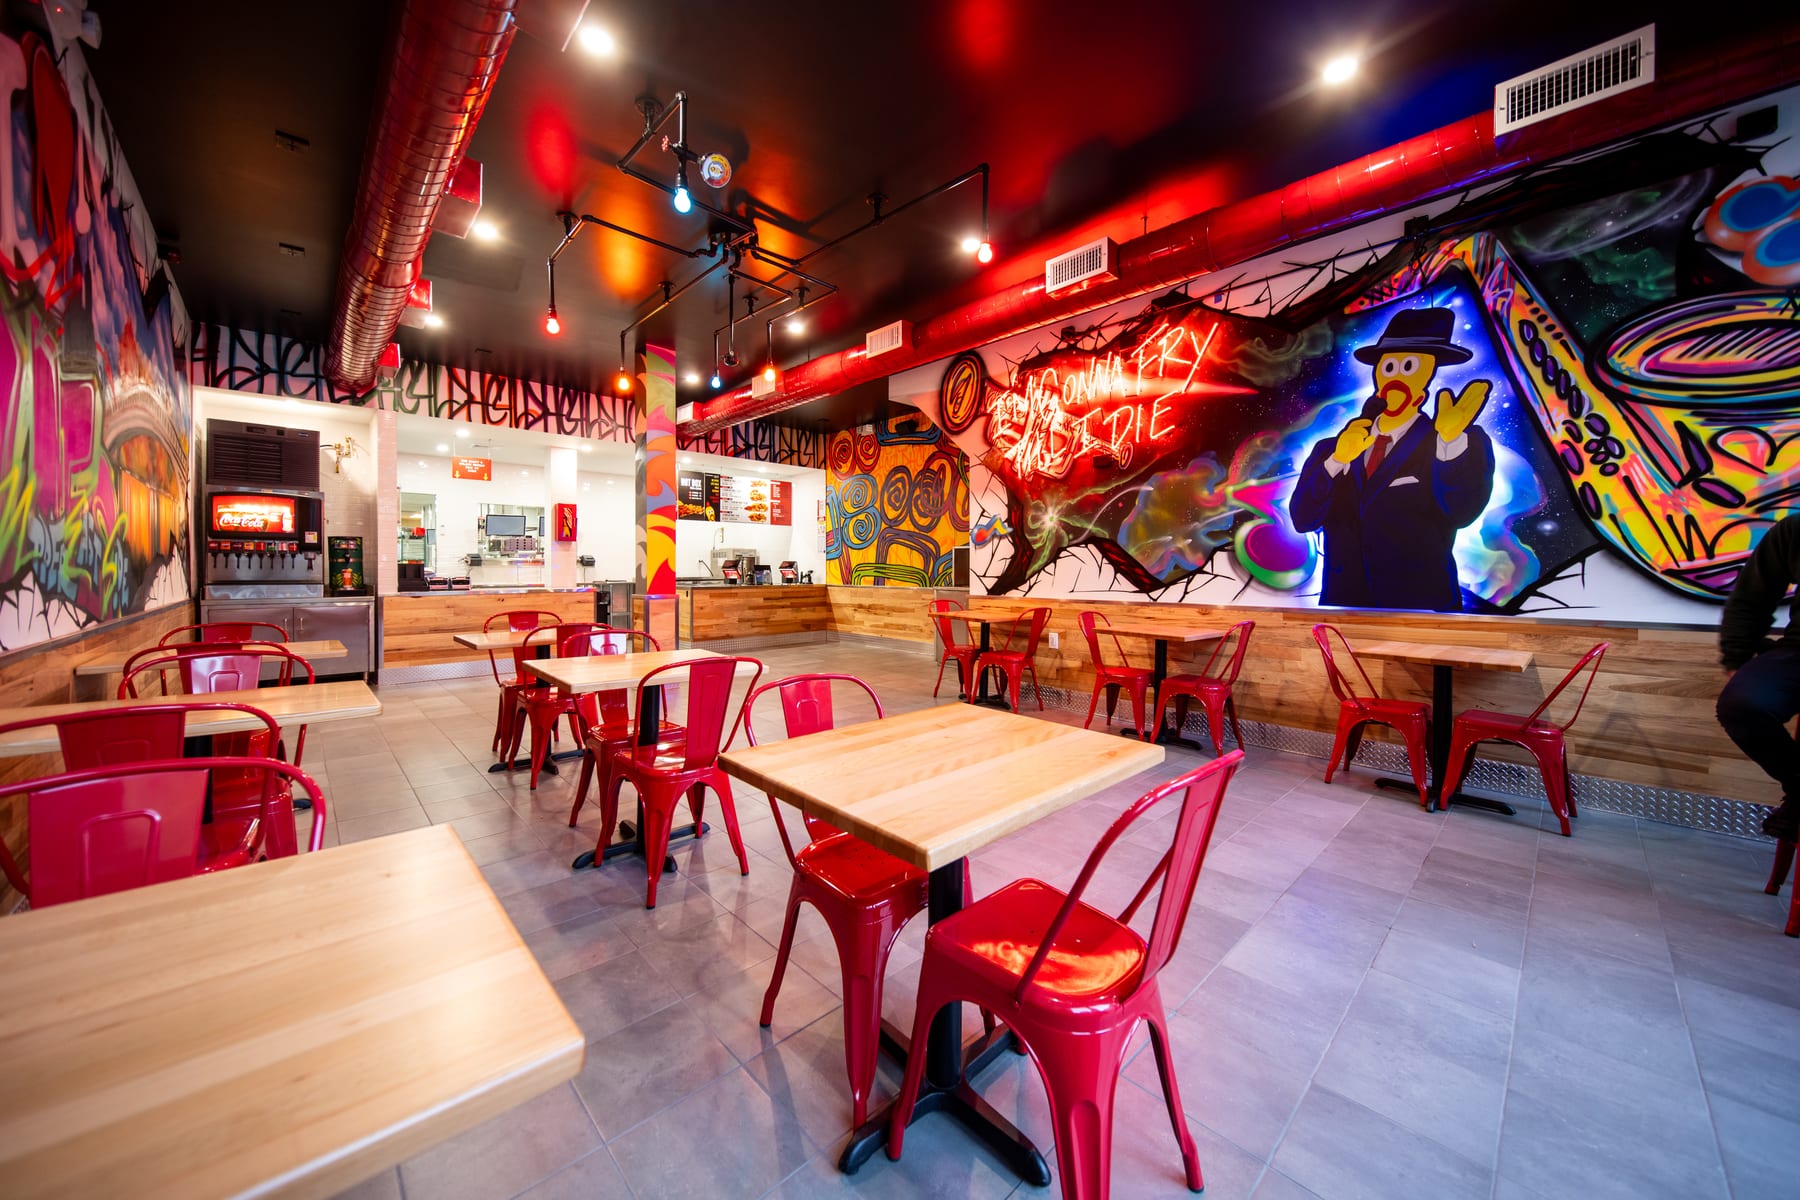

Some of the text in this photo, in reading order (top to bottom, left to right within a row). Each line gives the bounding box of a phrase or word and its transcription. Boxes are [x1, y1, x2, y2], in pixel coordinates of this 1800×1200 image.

[1039, 351, 1126, 422] GONNA
[1130, 322, 1219, 396] FRY
[1102, 390, 1178, 451] DIE
